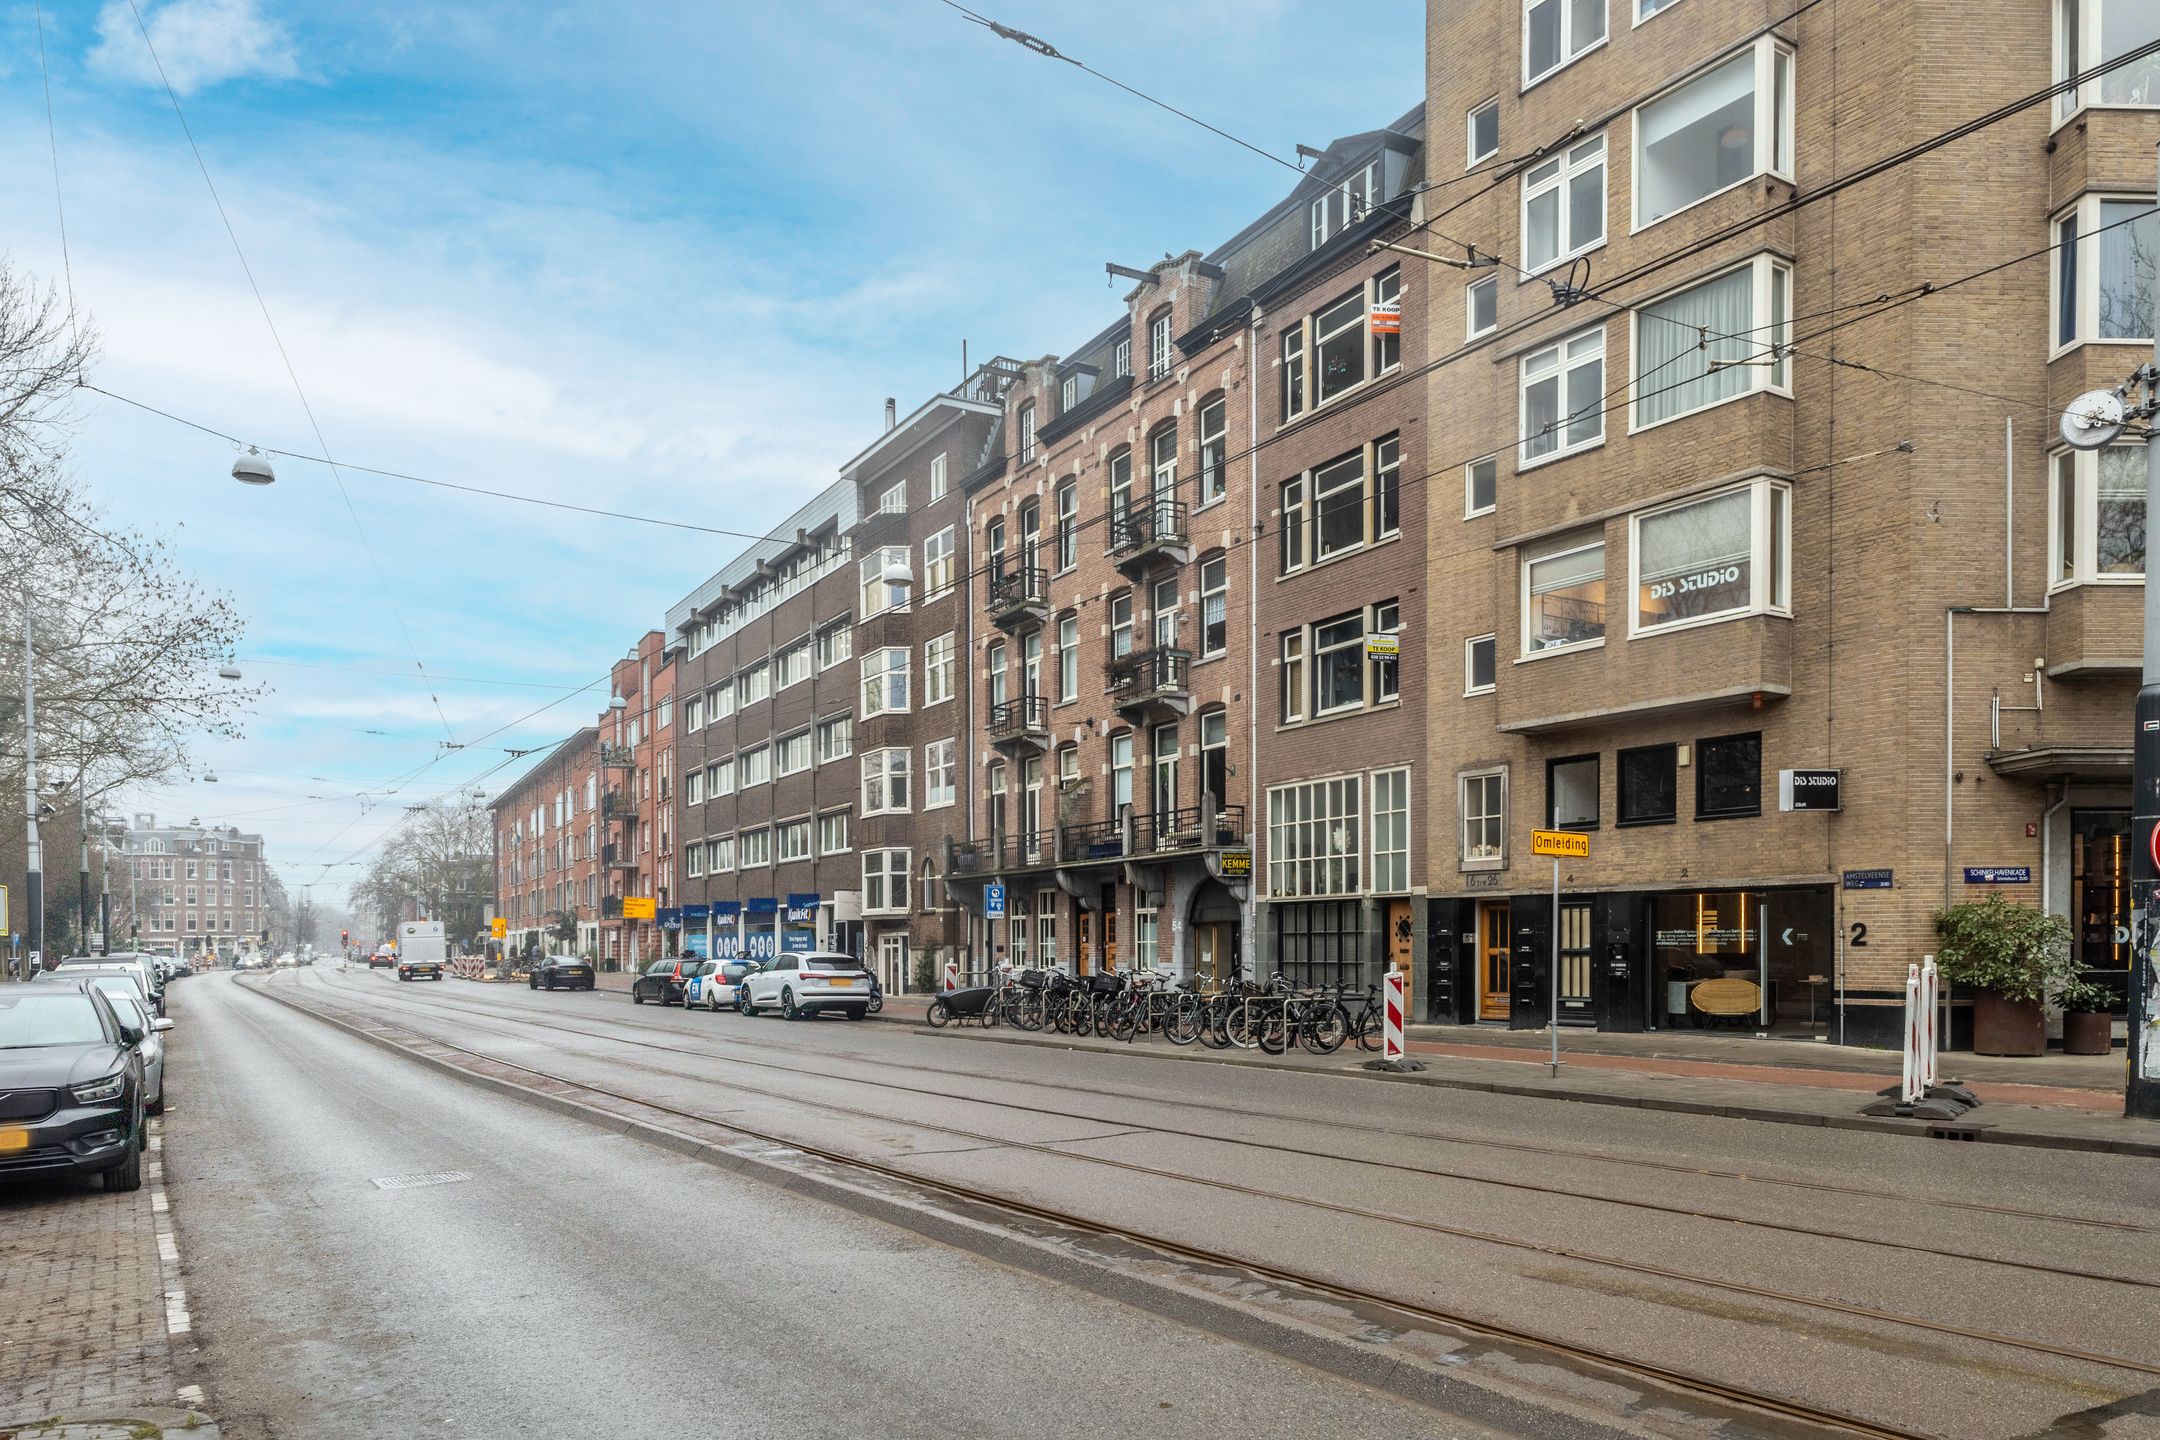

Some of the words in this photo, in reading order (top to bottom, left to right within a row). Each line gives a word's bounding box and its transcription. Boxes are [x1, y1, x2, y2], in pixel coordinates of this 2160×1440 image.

[1536, 835, 1587, 854] Omleiding
[1222, 859, 1251, 869] KEMME
[1680, 868, 1689, 878] 2
[1845, 871, 1890, 880] AMSTELVEENSE
[1970, 868, 2026, 876] SCHINKELHAVENKADE
[1567, 874, 1574, 883] 4
[1172, 920, 1183, 932] 54
[1851, 922, 1867, 947] 2
